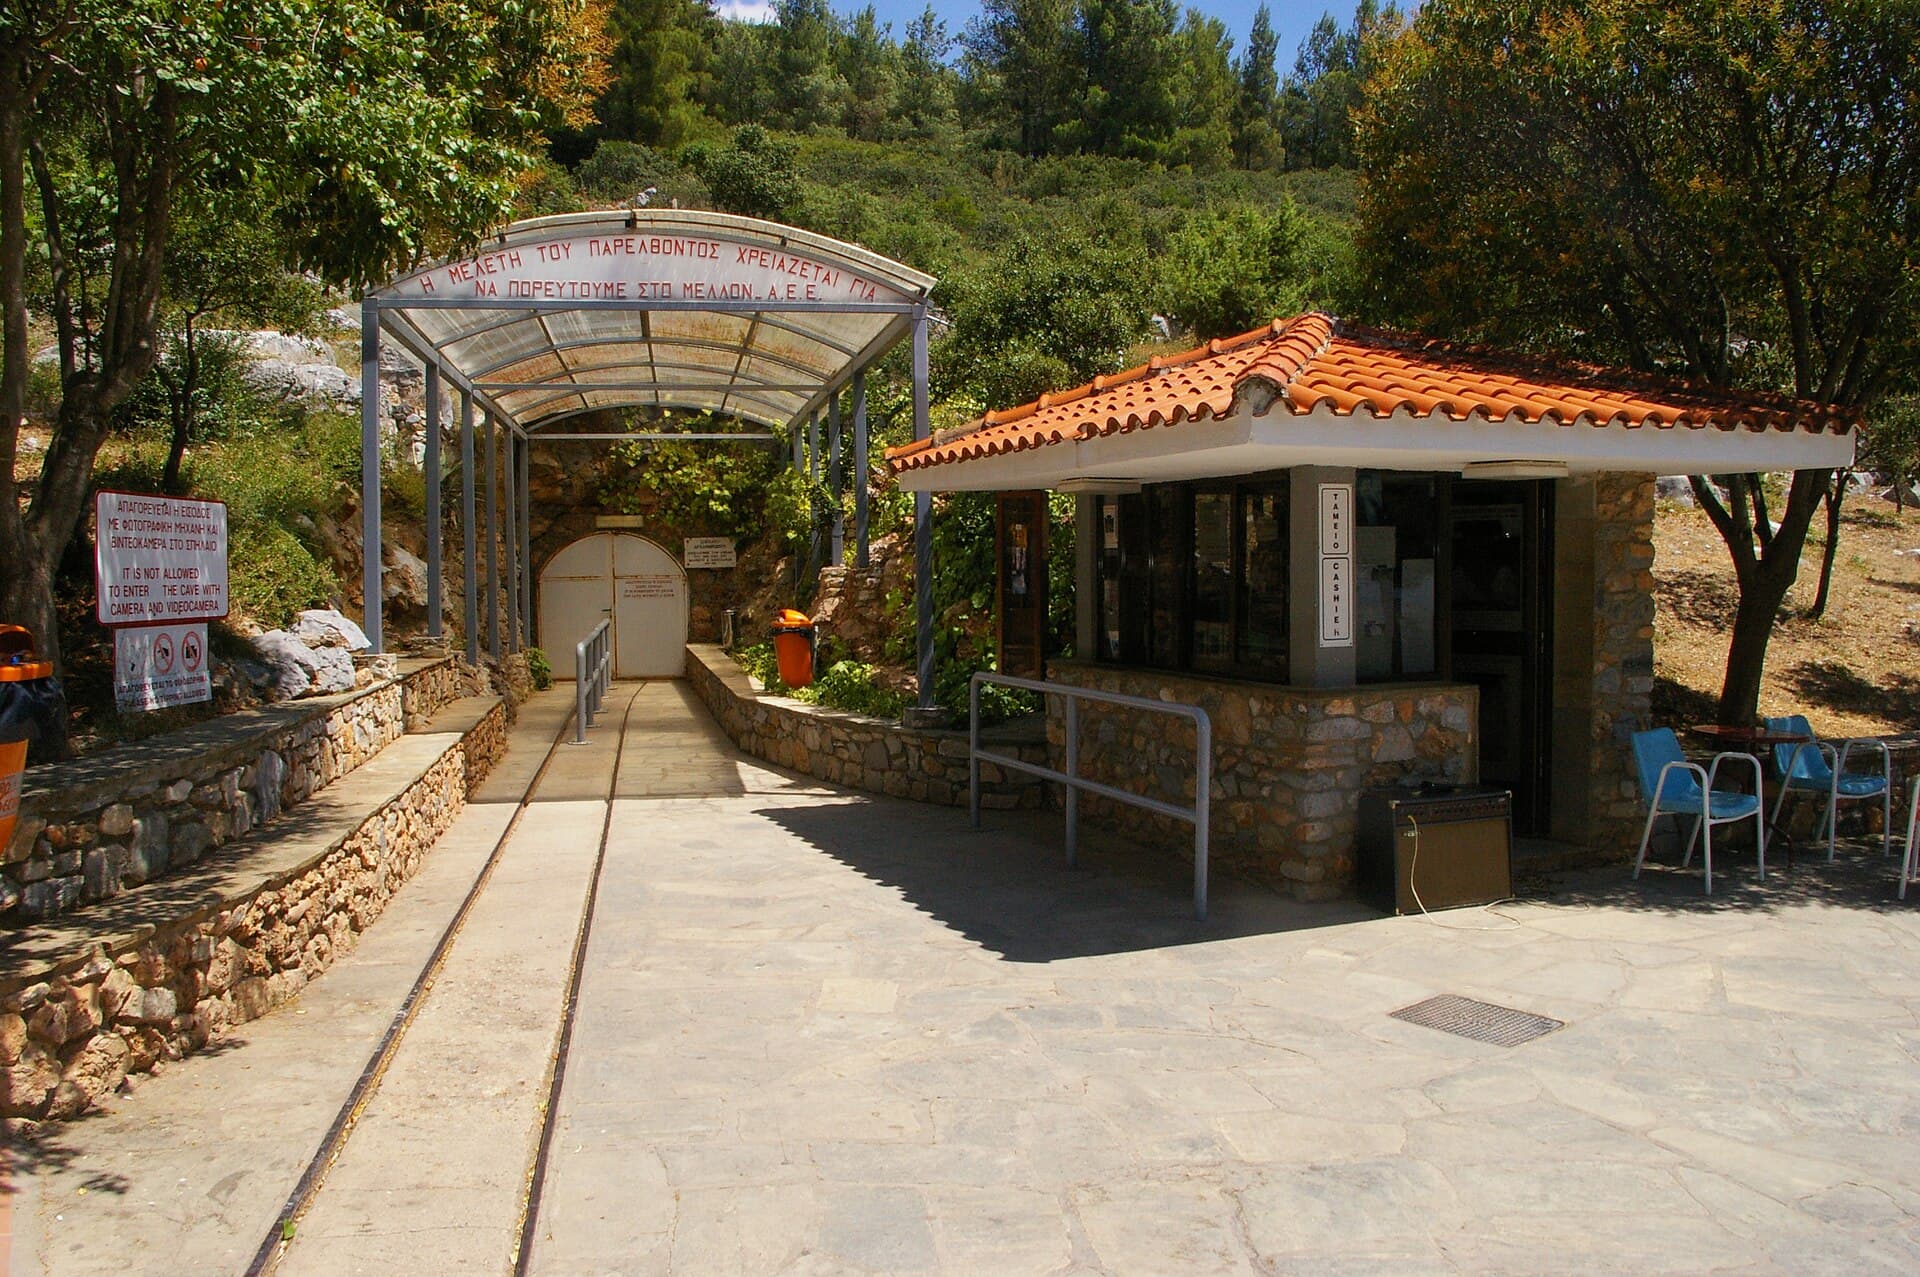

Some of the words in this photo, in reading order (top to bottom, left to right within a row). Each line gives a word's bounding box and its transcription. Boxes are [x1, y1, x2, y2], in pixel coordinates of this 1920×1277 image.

[420, 276, 435, 294] Η
[448, 250, 523, 285] ΜΕΛΕΤΗ
[537, 242, 572, 263] ΤΟΥ
[589, 238, 720, 259] ΠΑΡΕΛΘΟΝΤΟΣ
[736, 247, 840, 288] ΧΡΕΙΑΖΕΤΑΙ
[849, 278, 877, 302] ΓΙΑ
[475, 281, 497, 297] ΝΑ
[508, 280, 627, 298] ΠΟΡΕΥΤΟΥΜΕ
[638, 282, 672, 298] ΣΤΟ
[118, 500, 172, 515] ΑΠΑΓΟΡΕΥΕΤΑΙ
[108, 518, 119, 530] ΜΕ
[122, 519, 172, 533] ΦΩΤΟΓΡΑΦΙΚΗ
[174, 522, 204, 535] ΜΗΧΑΝΗ
[207, 524, 218, 535] ΚΑΙ
[111, 536, 167, 550] ΒΙΝΤΕΟΚΑΜΕΡΑ
[169, 539, 184, 550] ΣΤΟ
[123, 567, 130, 579] IT
[133, 567, 141, 579] IS
[144, 567, 160, 579] NOT
[163, 567, 200, 579] ALLOWED
[108, 585, 120, 598] TO
[123, 585, 149, 597] ENTER
[163, 584, 177, 596] THE
[181, 584, 199, 596] CAVE
[203, 584, 221, 595] WITH
[110, 602, 144, 616] CAMERA
[148, 602, 164, 614] AND
[167, 600, 219, 613] VIDEOCAMERA
